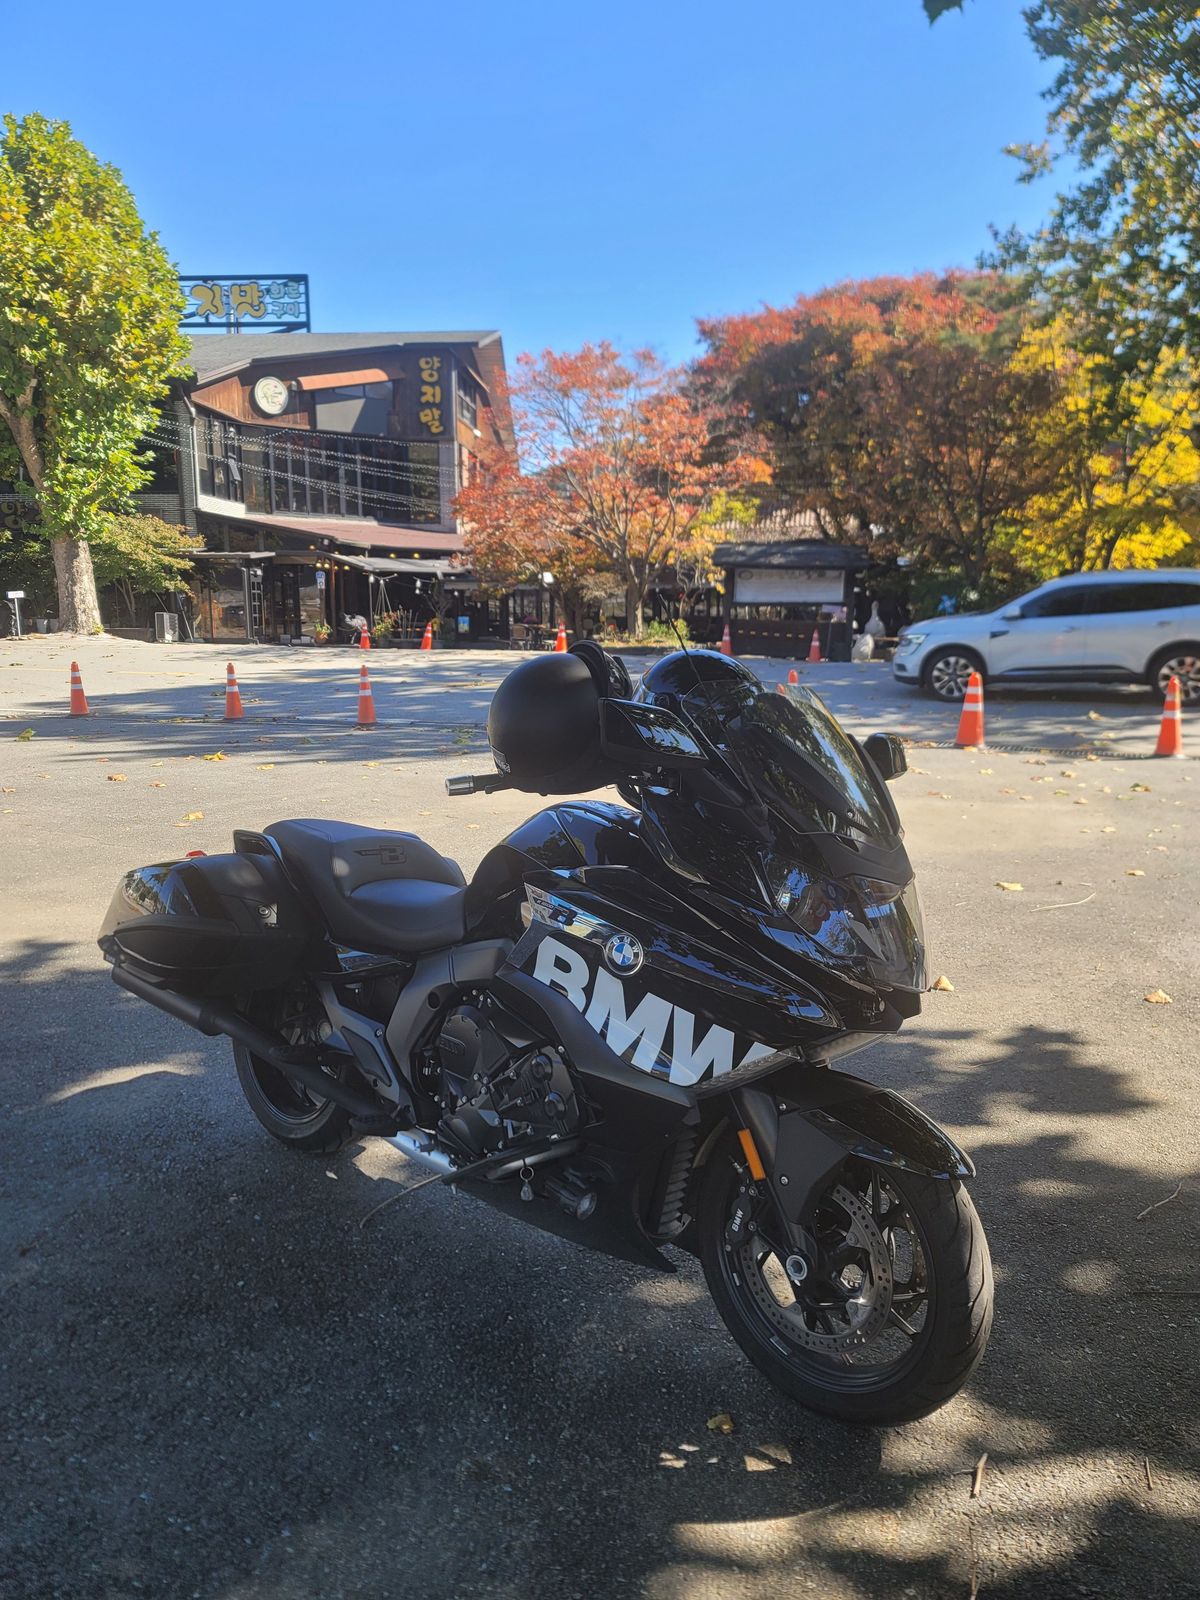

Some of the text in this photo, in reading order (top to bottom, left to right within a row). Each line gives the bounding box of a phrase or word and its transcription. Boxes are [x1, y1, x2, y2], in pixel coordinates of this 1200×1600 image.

[418, 356, 444, 434] 양지말
[533, 935, 777, 1087] BMW
[731, 1208, 744, 1232] BMW
